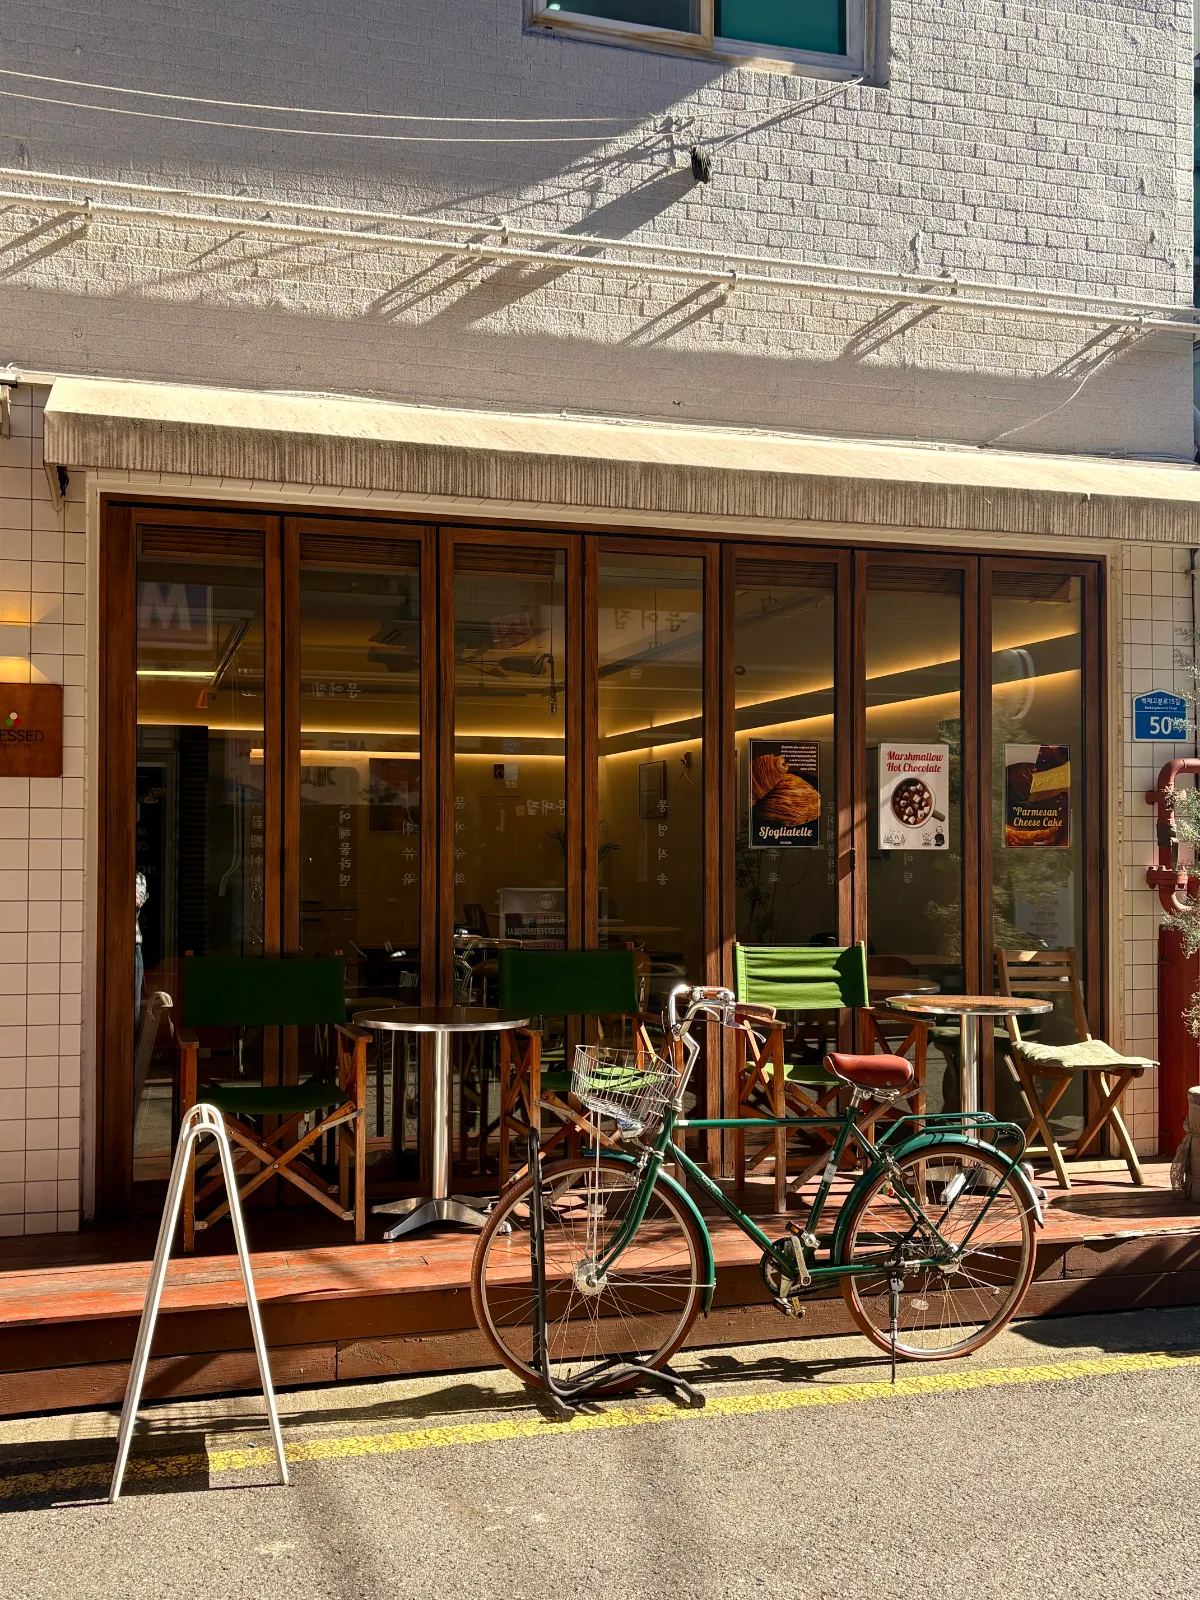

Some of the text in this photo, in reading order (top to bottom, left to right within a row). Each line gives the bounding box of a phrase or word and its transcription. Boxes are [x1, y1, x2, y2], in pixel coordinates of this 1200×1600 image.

[1150, 716, 1171, 734] 50
[887, 751, 944, 762] Marshmallow
[887, 762, 942, 773] Hot Chocolate
[1012, 806, 1062, 817] "Parmesan"
[1013, 816, 1063, 827] Cheese Cake
[759, 826, 813, 840] Sfogliatelle
